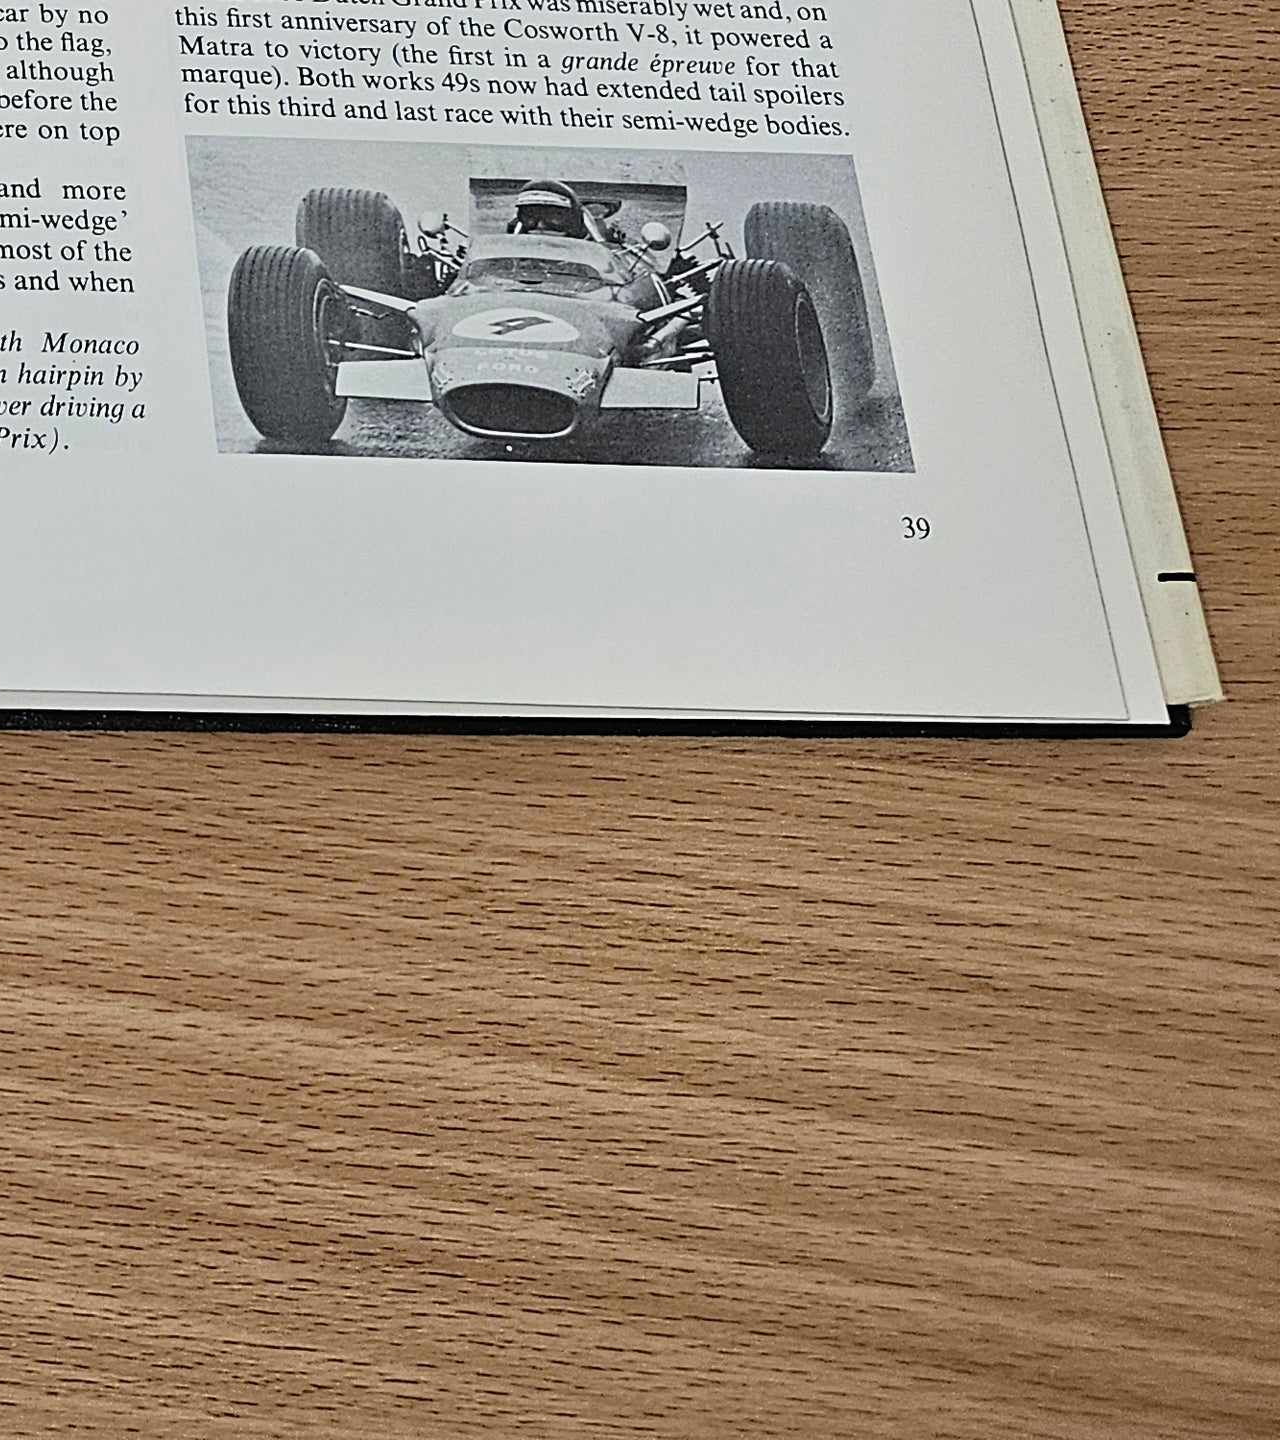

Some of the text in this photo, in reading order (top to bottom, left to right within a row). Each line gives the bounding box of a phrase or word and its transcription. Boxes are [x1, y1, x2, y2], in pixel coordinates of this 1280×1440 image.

[693, 2, 735, 18] wet
[740, 0, 791, 23] and,
[797, 6, 827, 21] on
[178, 35, 840, 78] Matra to victory (the first in a grande épreuve for that
[184, 92, 849, 138] for this third and last race with their semi-wedge bodies.
[14, 269, 60, 291] and
[68, 270, 135, 293] when
[41, 332, 139, 355] Monaco
[40, 394, 124, 424] driving
[131, 404, 145, 419] a
[901, 516, 931, 540] 39
